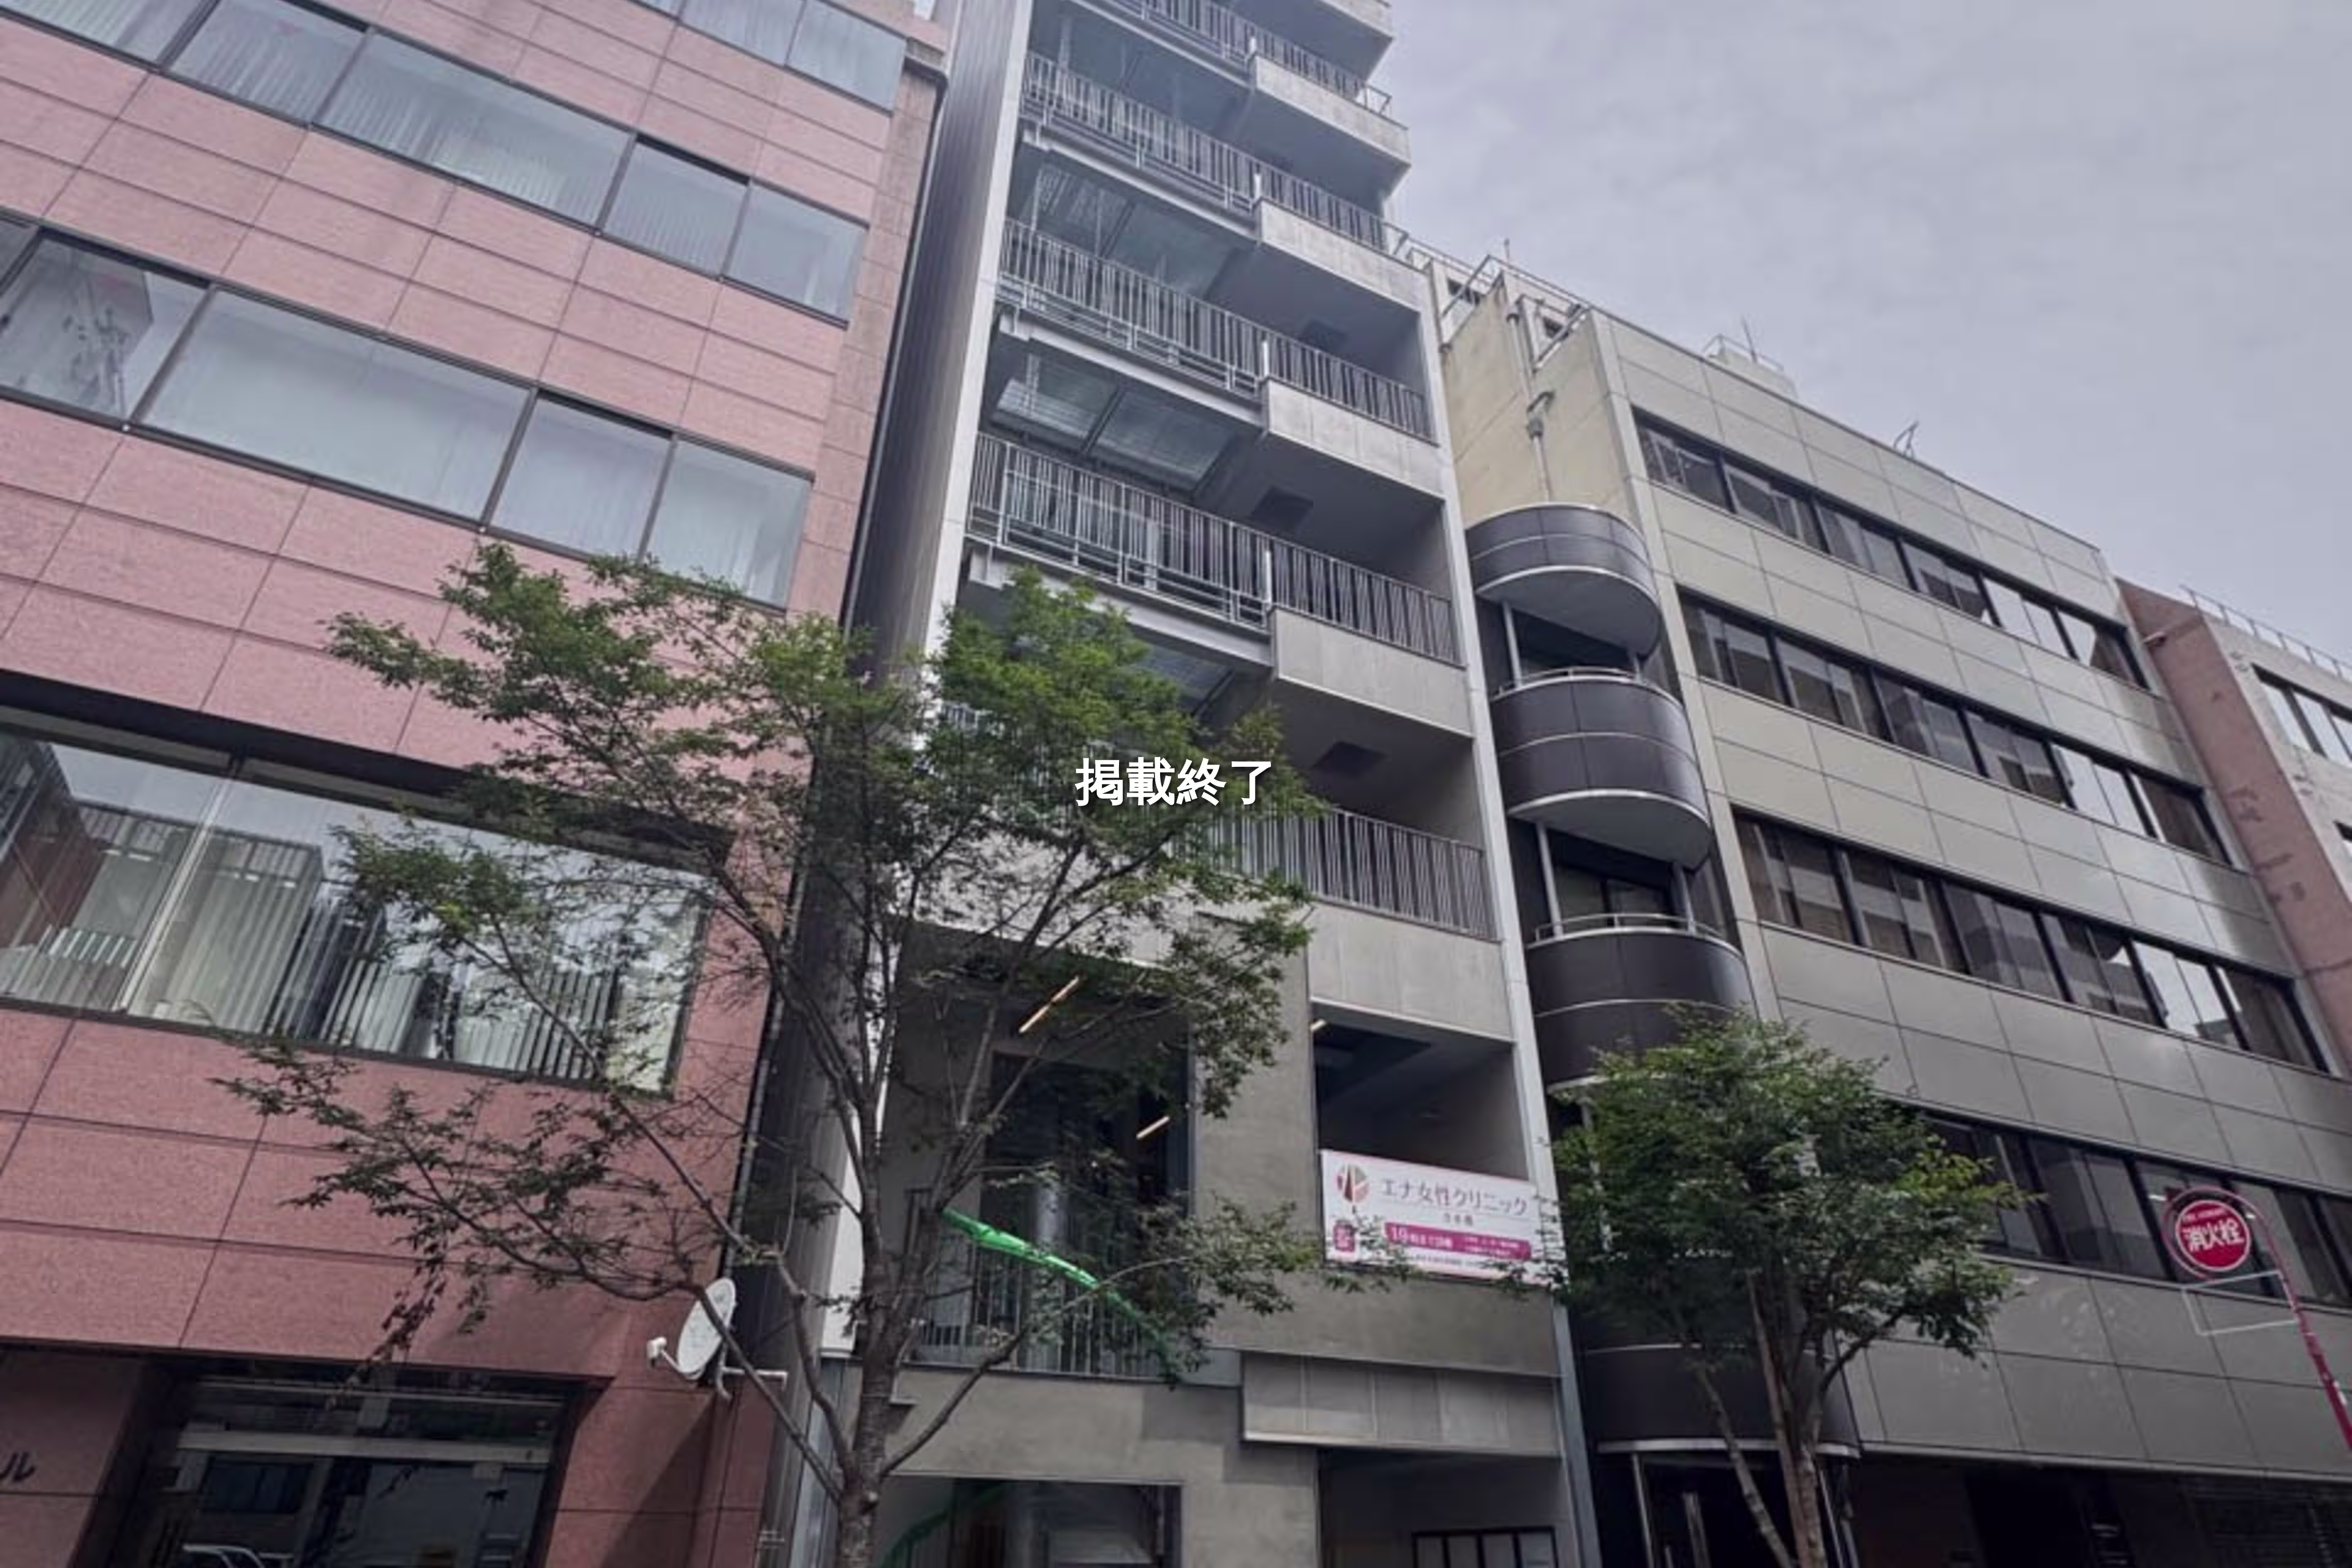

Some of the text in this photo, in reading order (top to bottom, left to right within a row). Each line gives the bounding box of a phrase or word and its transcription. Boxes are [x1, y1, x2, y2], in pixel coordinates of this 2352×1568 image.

[1382, 1178, 1528, 1216] エナ女性クリニック
[2182, 1218, 2245, 1253] 消火栓
